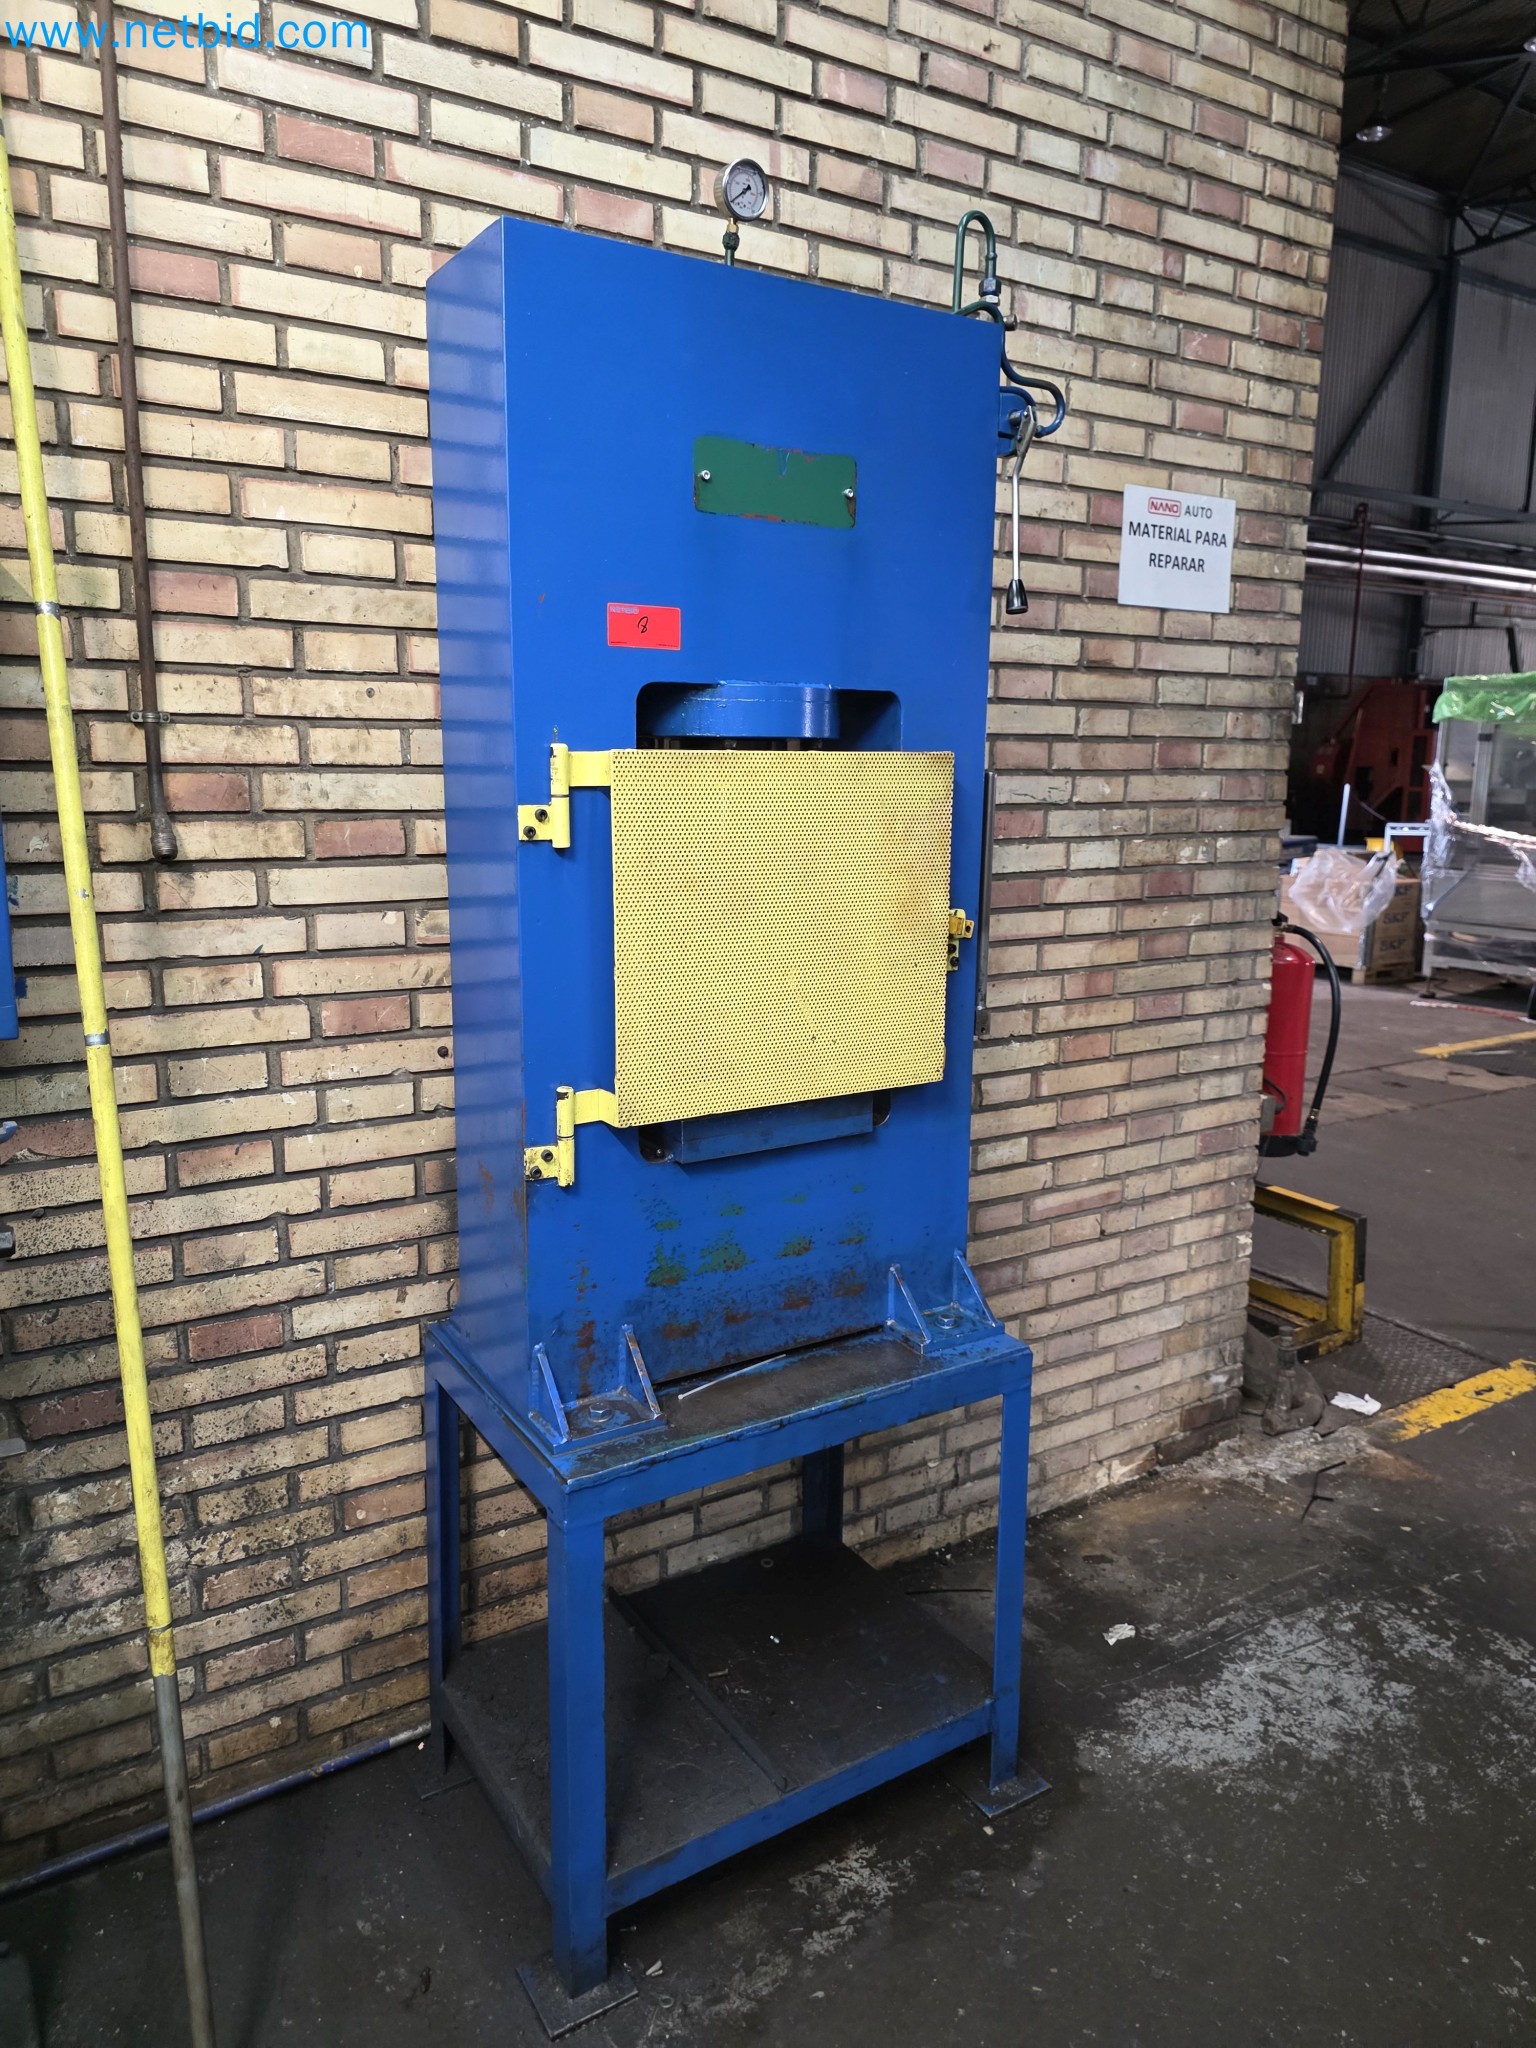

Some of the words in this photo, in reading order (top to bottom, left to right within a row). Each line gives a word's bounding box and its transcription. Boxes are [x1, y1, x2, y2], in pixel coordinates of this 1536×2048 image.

[1150, 501, 1179, 514] NANO
[1184, 505, 1213, 519] AUTO
[1128, 521, 1192, 543] MATERIAL
[1195, 530, 1227, 548] PARA
[1149, 553, 1205, 573] REPARAR
